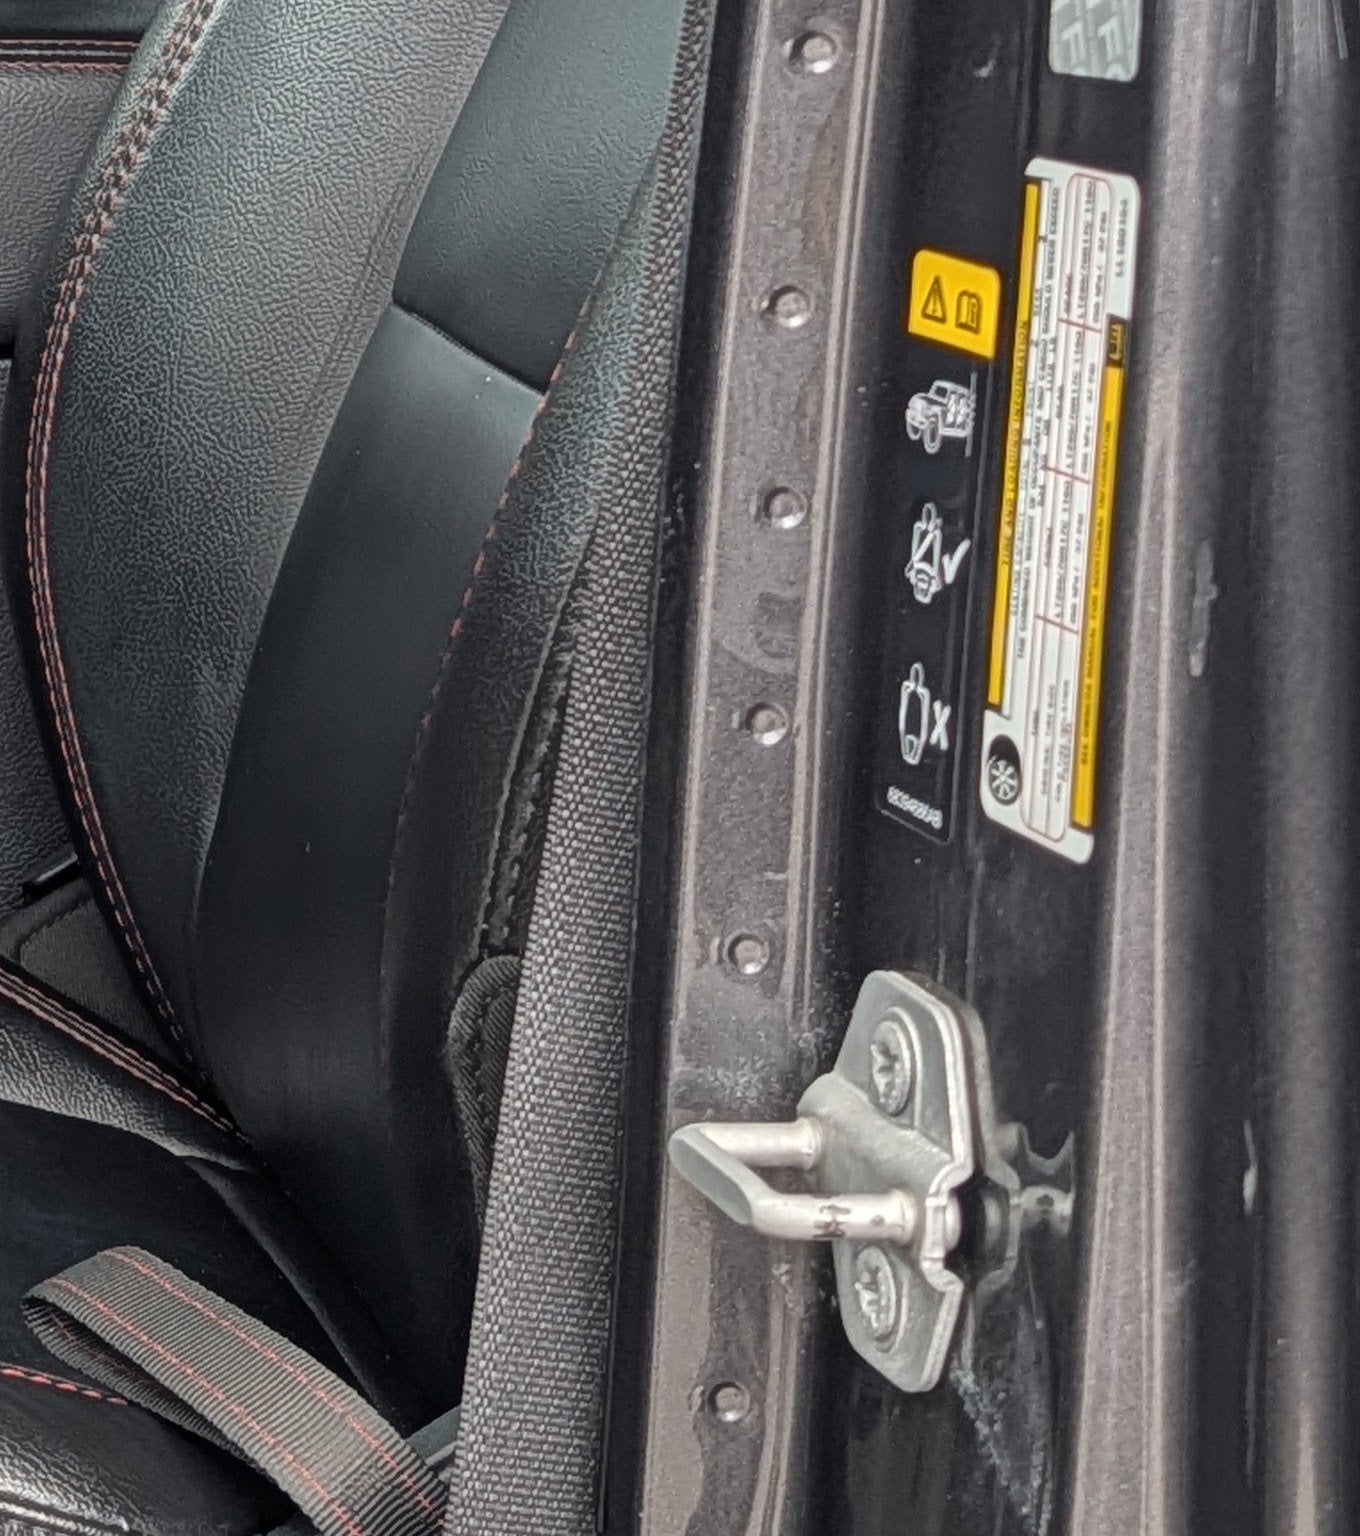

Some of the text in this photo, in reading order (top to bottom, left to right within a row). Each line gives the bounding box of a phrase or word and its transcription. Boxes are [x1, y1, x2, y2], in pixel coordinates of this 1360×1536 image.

[1011, 318, 1029, 426] INFORMATION
[1006, 426, 1020, 493] LOADING
[1003, 496, 1015, 528] AND
